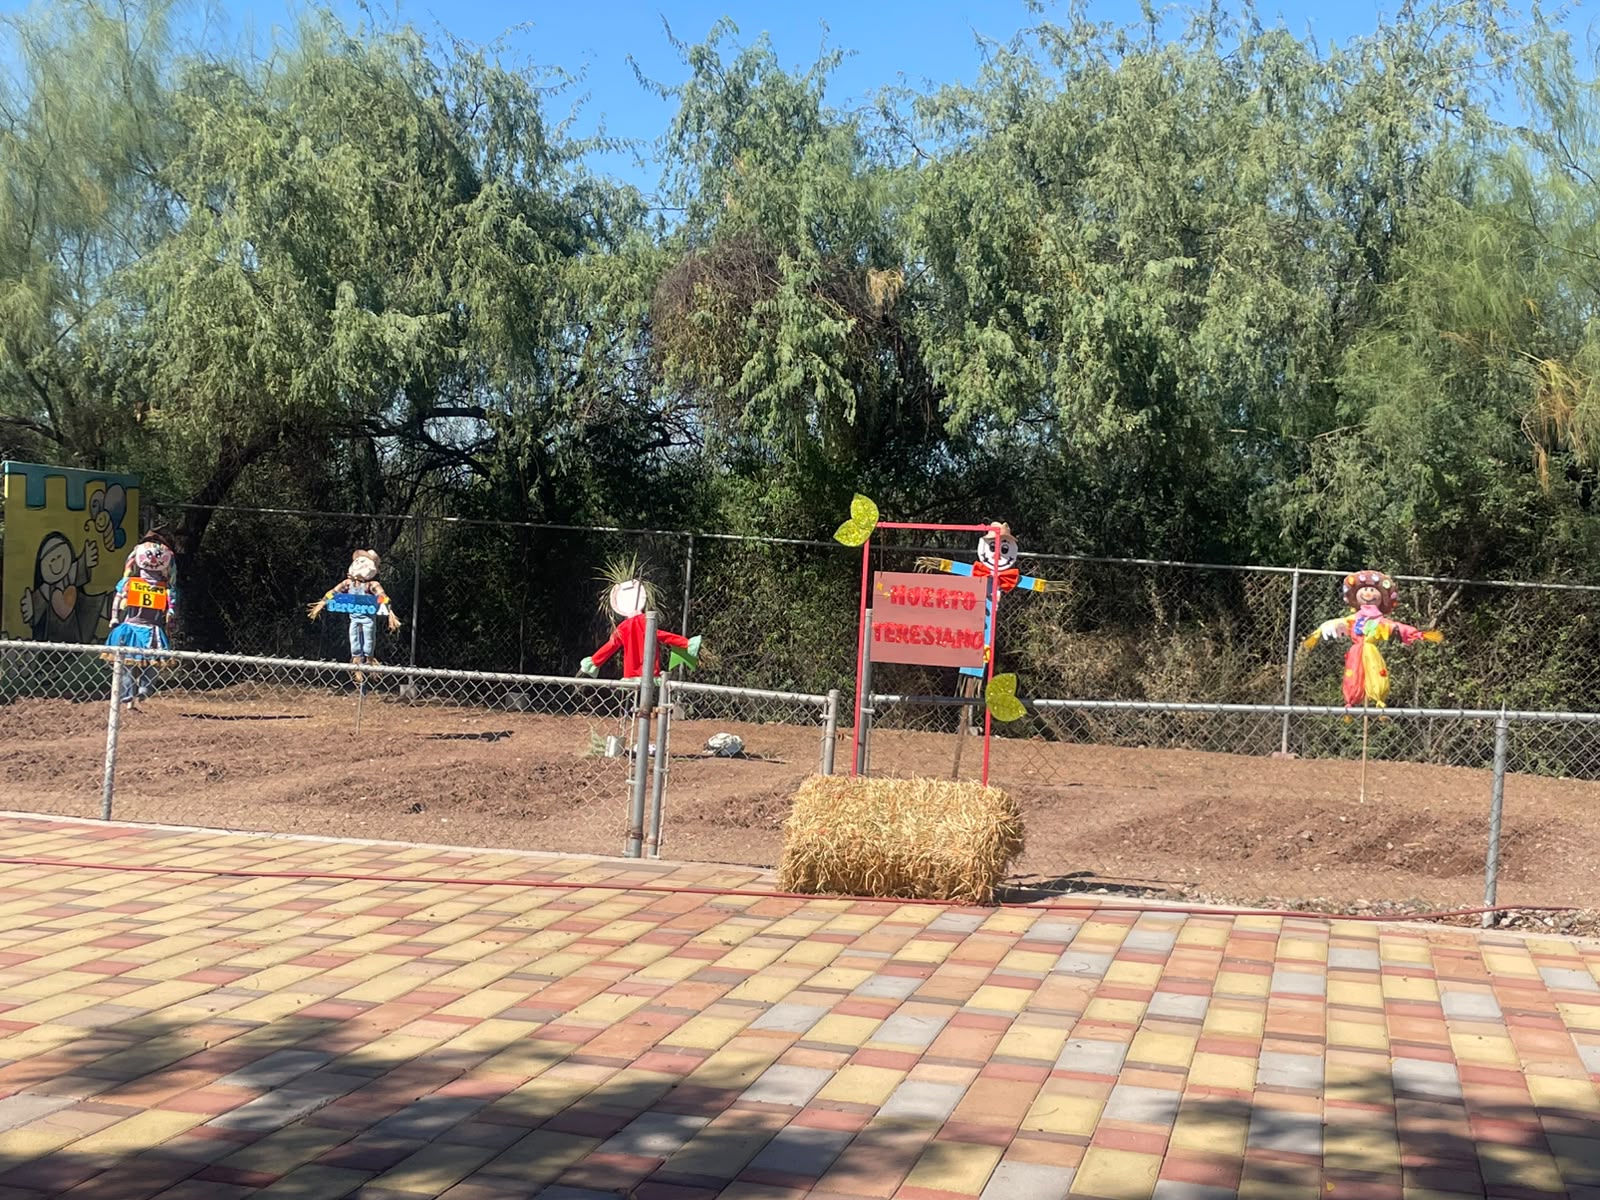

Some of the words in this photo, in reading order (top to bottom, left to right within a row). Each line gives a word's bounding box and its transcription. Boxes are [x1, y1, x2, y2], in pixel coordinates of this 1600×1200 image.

[142, 593, 152, 606] B
[890, 585, 977, 611] HUERTO
[872, 621, 984, 650] TERESIANO
